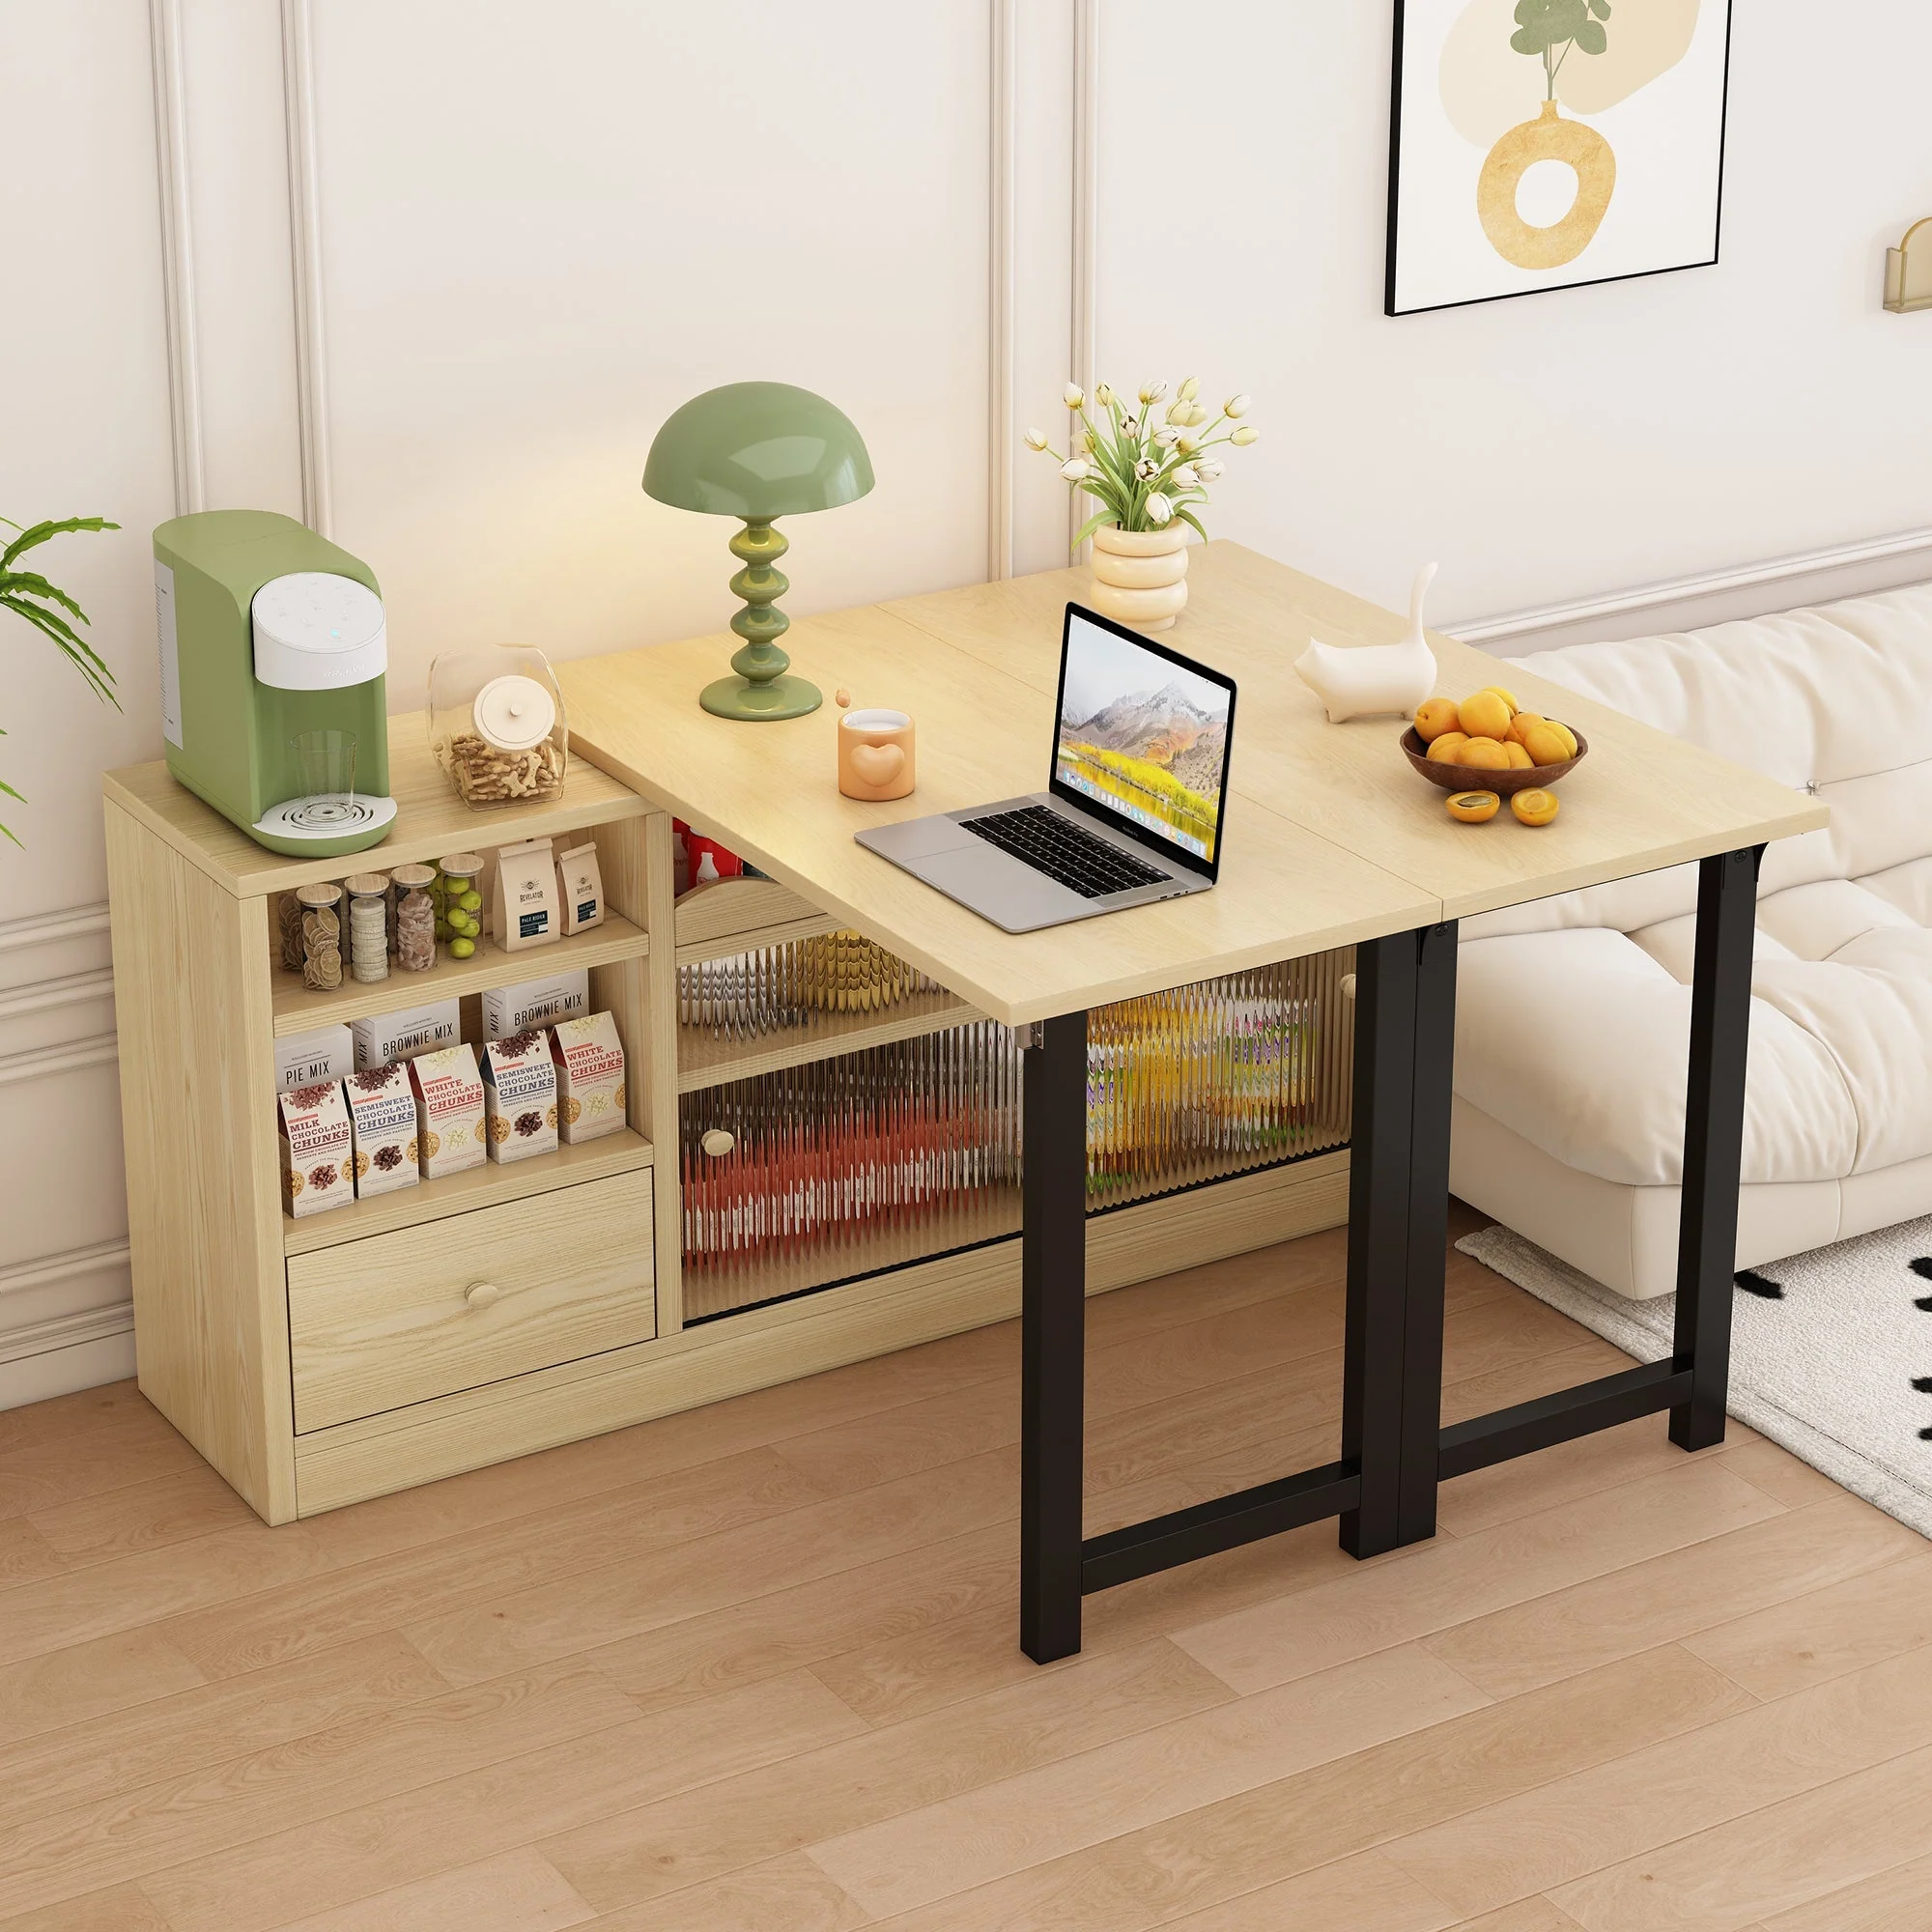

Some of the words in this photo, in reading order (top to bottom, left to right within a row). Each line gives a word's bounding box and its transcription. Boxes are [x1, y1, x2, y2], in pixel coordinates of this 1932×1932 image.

[514, 1000, 559, 1026] BROWNIE
[564, 993, 582, 1010] MIX
[490, 1010, 499, 1034] MIX
[383, 1030, 430, 1057] BROWNIE
[435, 1022, 453, 1040] MIX
[358, 1041, 368, 1064] MIX
[567, 1045, 604, 1061] WHITE
[569, 1049, 622, 1068] CHOCOLATE
[286, 1067, 303, 1085] PIE
[309, 1061, 329, 1078] MIX
[497, 1062, 552, 1081] SEMISWEET
[571, 1057, 623, 1077] CHUNKS
[425, 1078, 463, 1094] WHITE
[498, 1069, 554, 1088] CHOCOLATE
[499, 1077, 554, 1097] CHUNKS
[427, 1082, 482, 1102] CHOCOLATE
[429, 1091, 483, 1112] CHUNKS
[355, 1094, 412, 1115] SEMISWEET
[356, 1102, 413, 1122] CHOCOLATE
[290, 1119, 321, 1133] MILK
[358, 1110, 415, 1131] CHUNKS
[292, 1121, 349, 1141] CHOCOLATE
[293, 1128, 350, 1151] CHUNKS
